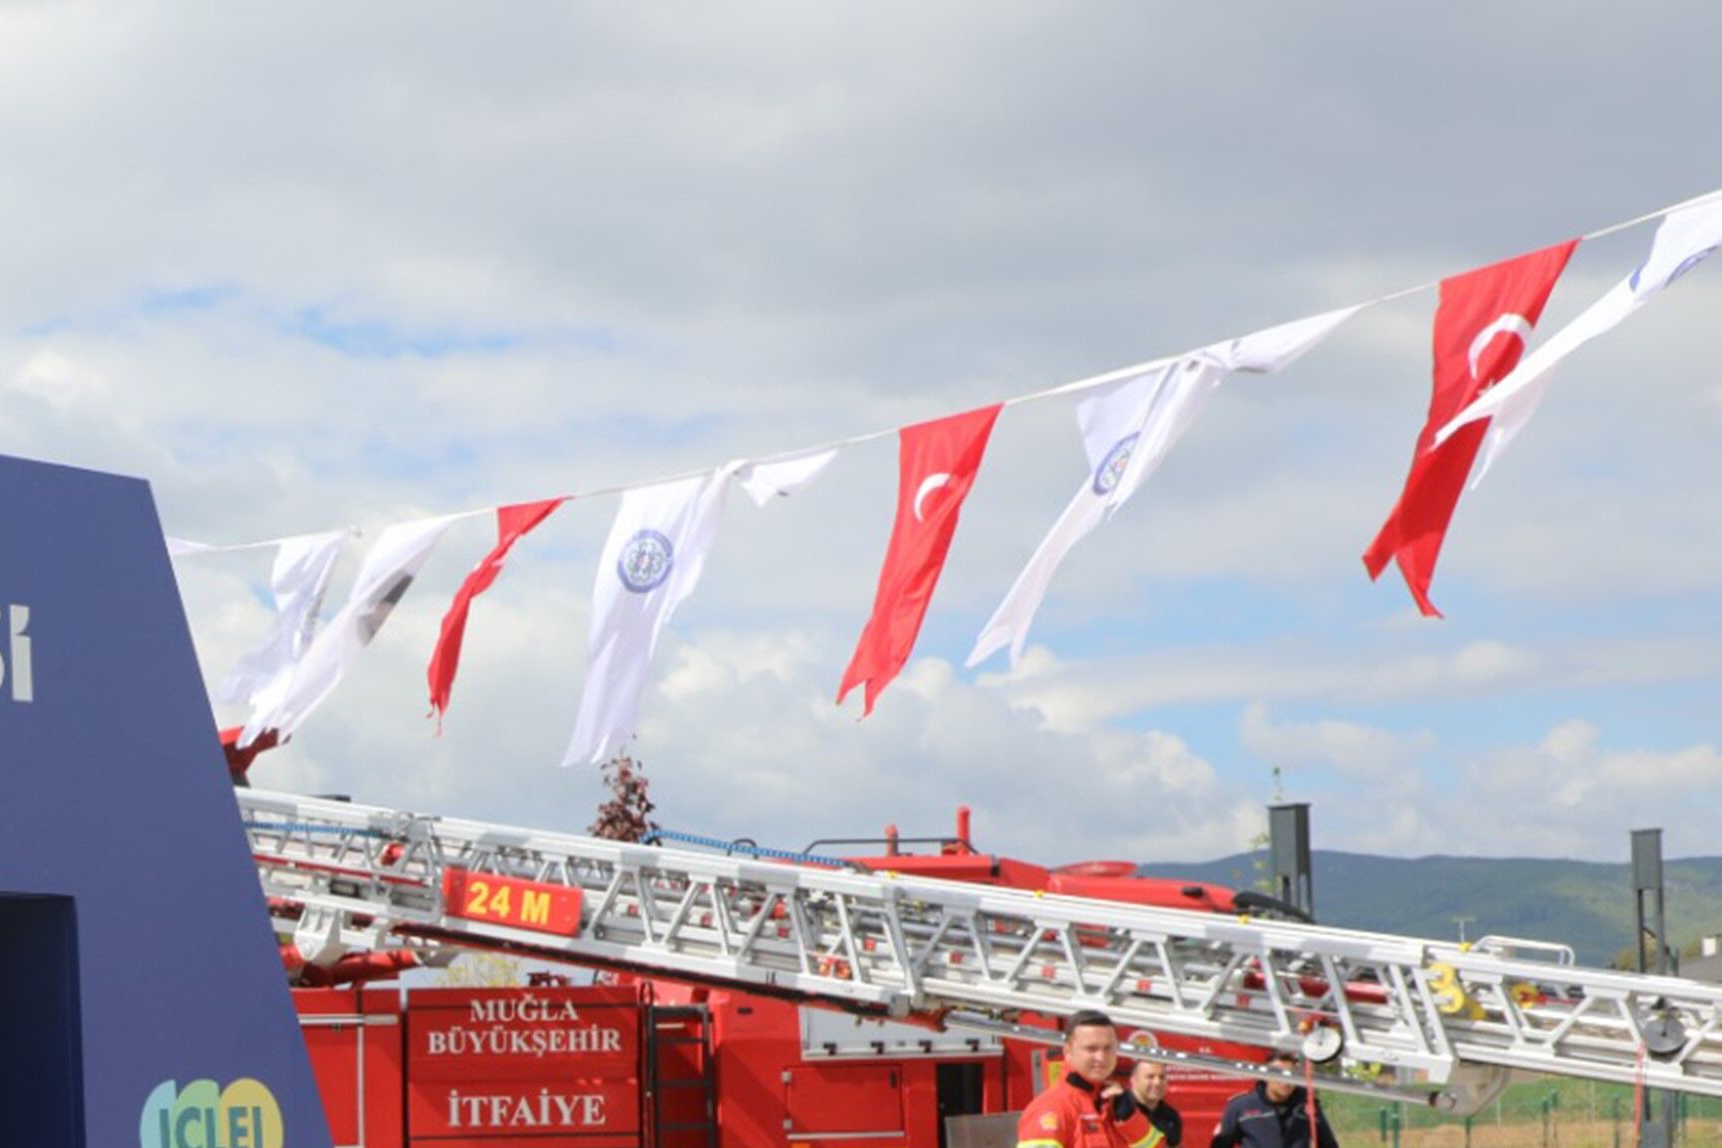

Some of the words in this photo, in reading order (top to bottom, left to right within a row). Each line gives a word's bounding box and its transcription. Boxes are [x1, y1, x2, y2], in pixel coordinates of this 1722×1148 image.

[466, 881, 512, 918] 24
[520, 889, 551, 926] M
[469, 993, 580, 1022] MUĞLA
[428, 1024, 621, 1058] BÜYÜKŞEHİR
[447, 1087, 606, 1127] İTFAİYE
